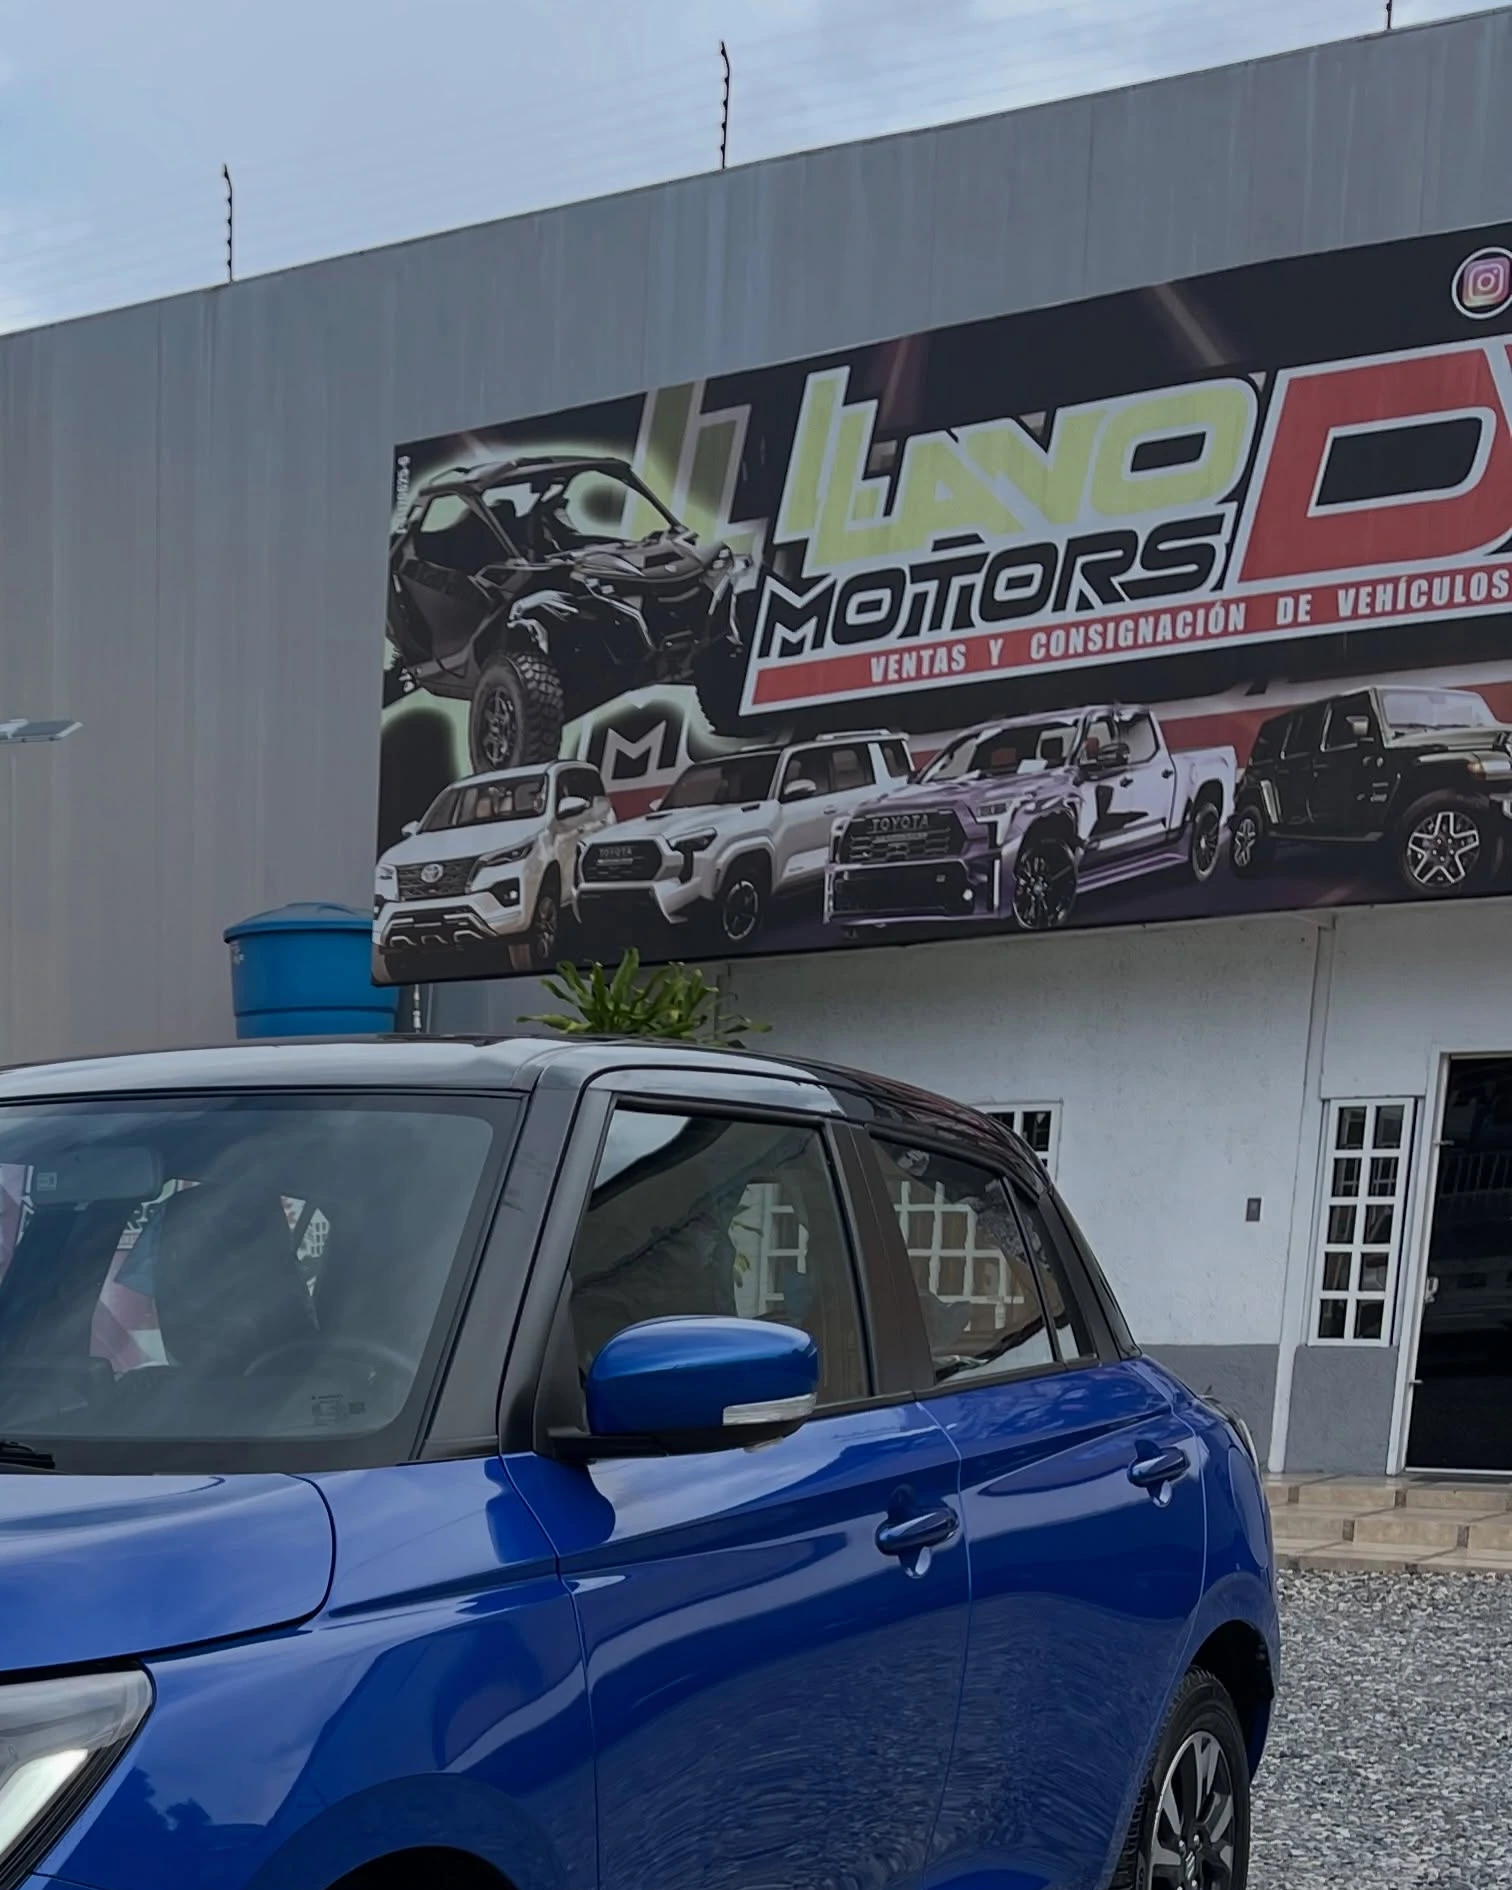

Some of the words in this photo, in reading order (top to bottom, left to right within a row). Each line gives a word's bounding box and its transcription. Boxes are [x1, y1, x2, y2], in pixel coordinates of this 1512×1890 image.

[776, 368, 1256, 575] LLANO
[758, 510, 1227, 659] MOTORS
[870, 643, 967, 683] VENTAS
[988, 639, 1007, 667] Y
[1029, 601, 1247, 660] CONSIGNACIÓN
[1276, 594, 1313, 625] DE
[1337, 568, 1511, 618] VEHÍCULOS
[871, 814, 930, 833] TOYOTA
